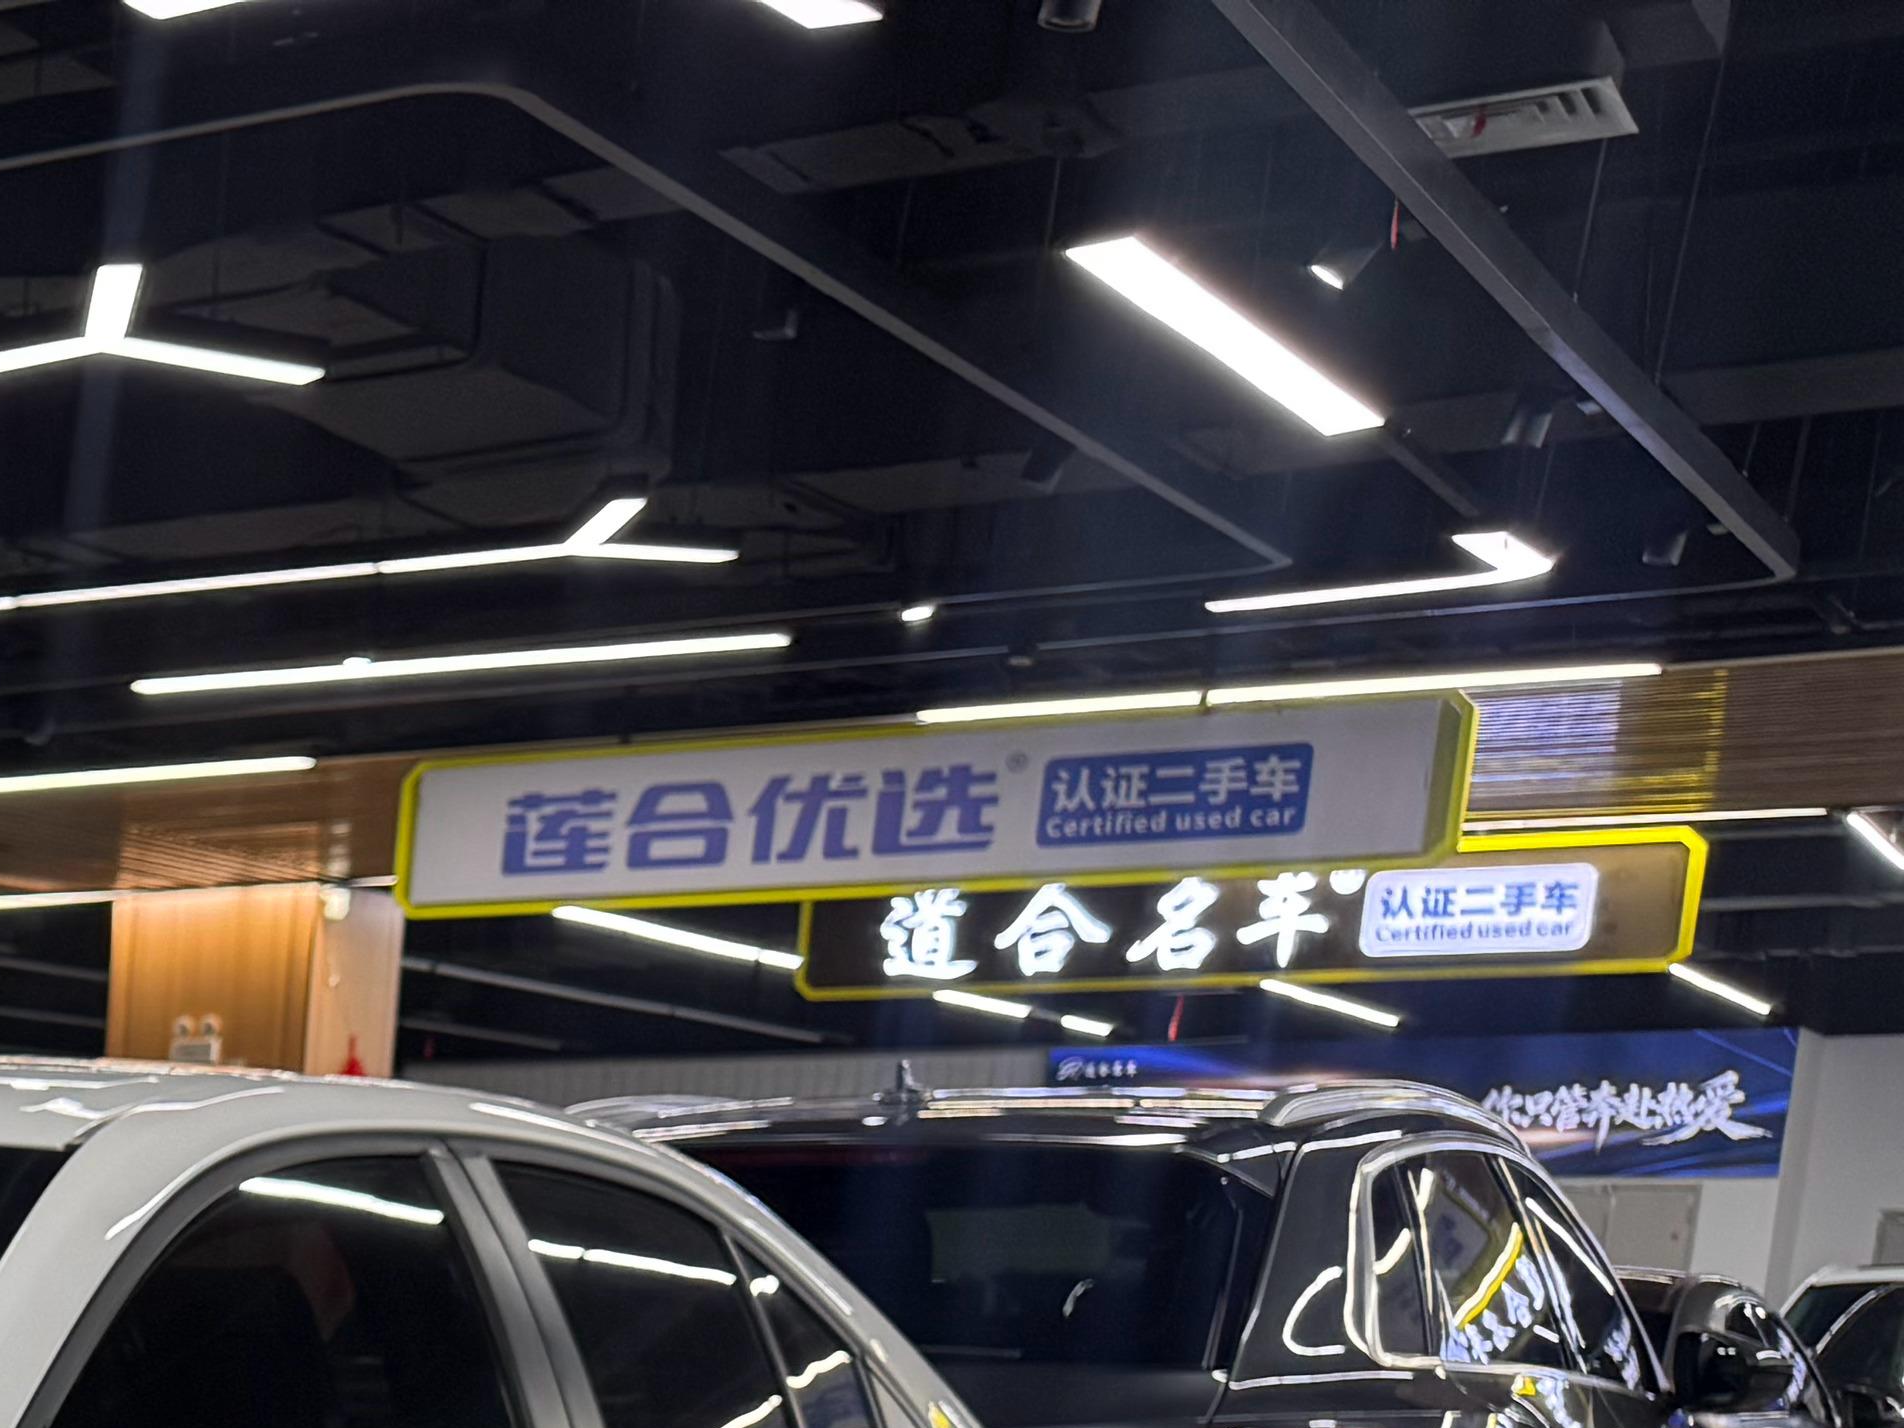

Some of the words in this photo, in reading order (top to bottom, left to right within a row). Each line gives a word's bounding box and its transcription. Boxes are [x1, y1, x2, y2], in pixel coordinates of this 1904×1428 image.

[1051, 755, 1302, 813] 认证二手车
[1046, 809, 1166, 838] Certified
[1175, 806, 1242, 831] used
[1250, 807, 1296, 827] car
[1380, 880, 1580, 919] 认证二手车
[1375, 922, 1473, 942] Certified
[1478, 920, 1532, 938] used
[1537, 922, 1573, 937] car
[1482, 1069, 1773, 1154] 你只管奔赴热爱
